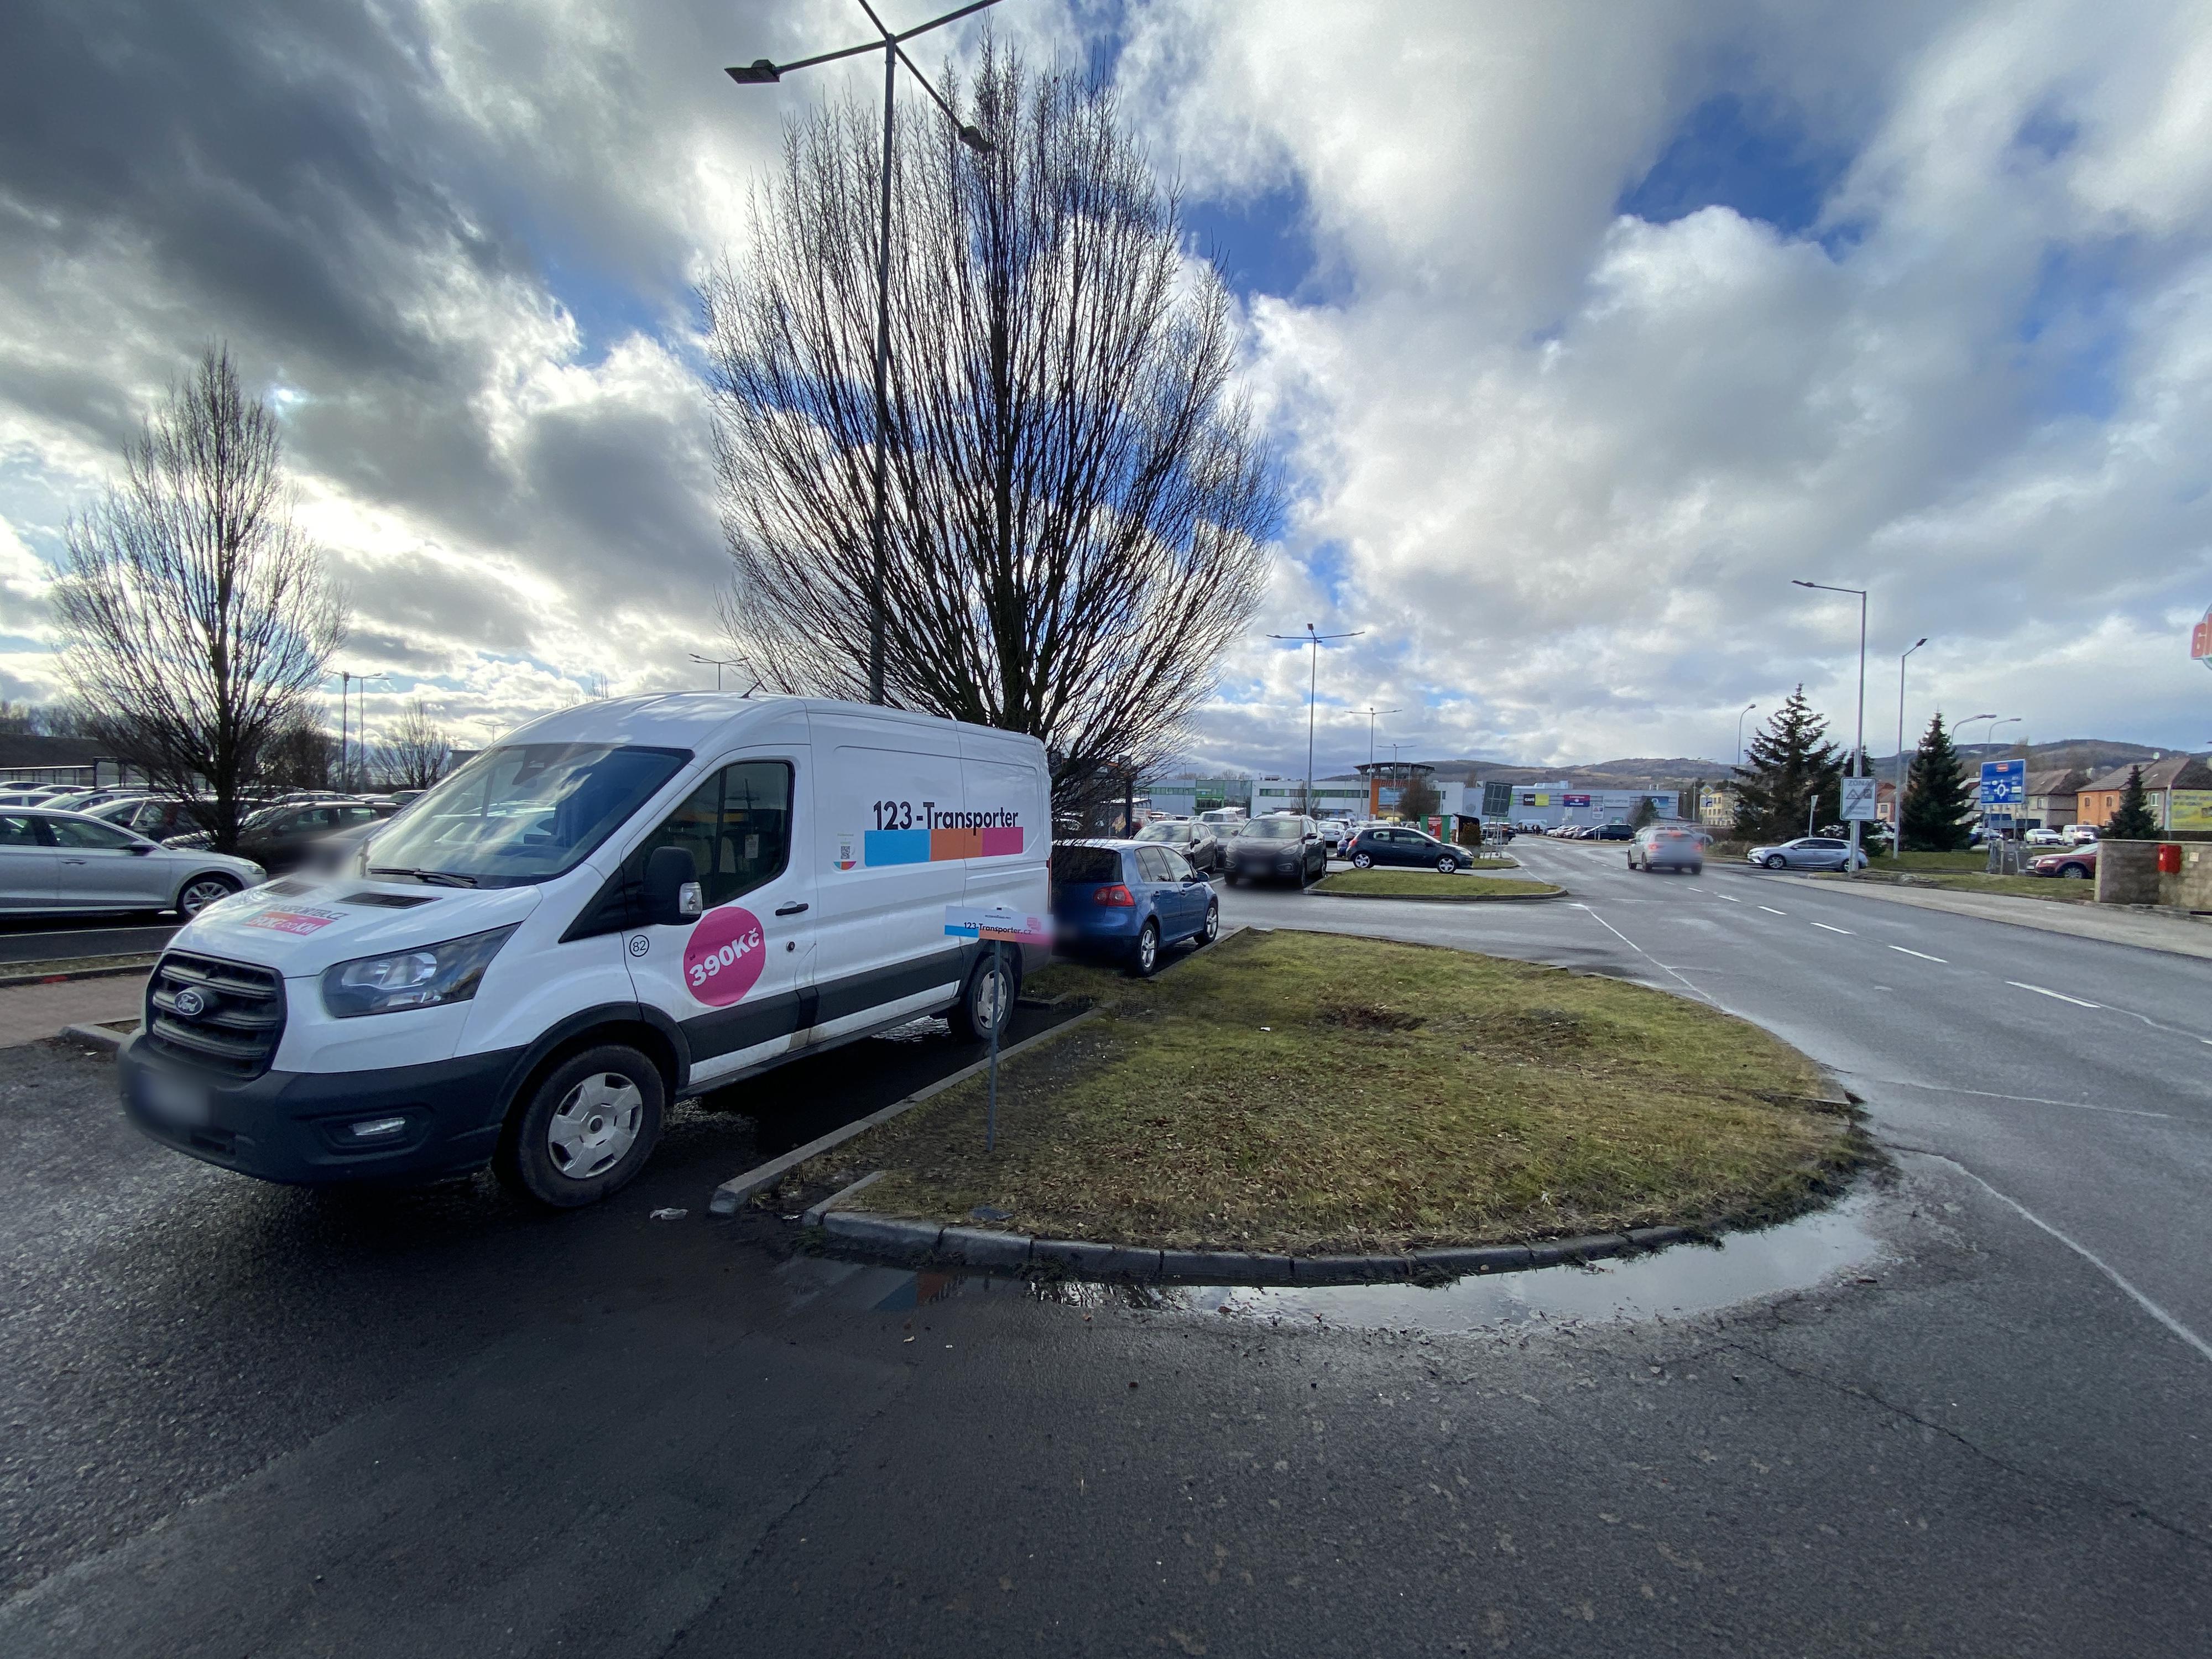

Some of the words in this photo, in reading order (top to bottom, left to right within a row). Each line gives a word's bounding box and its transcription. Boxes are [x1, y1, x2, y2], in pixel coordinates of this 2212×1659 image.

[873, 801, 1018, 836] 123-Transporter
[964, 922, 1032, 934] 123-Transporter.cz
[633, 940, 646, 952] 82
[690, 927, 760, 987] 390Kč
[178, 994, 197, 1011] Ford
